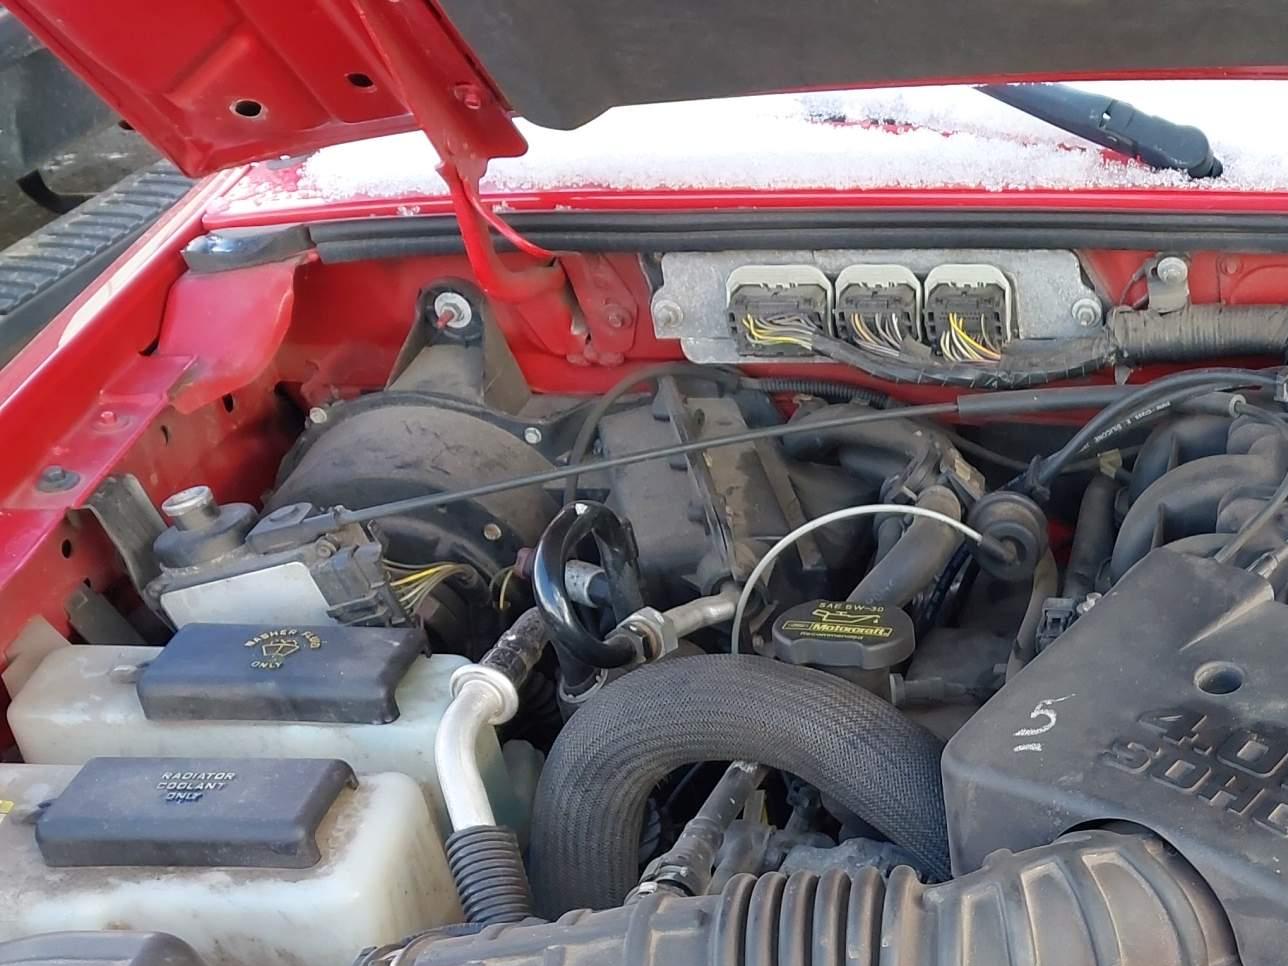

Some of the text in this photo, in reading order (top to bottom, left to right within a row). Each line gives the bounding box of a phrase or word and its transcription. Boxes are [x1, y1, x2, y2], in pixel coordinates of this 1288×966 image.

[819, 602, 843, 610] SAE
[812, 622, 885, 636] Motorcraft
[250, 660, 283, 669] ONLY
[161, 771, 236, 780] RADIATOR
[156, 782, 226, 790] COOLANT
[166, 791, 204, 801] ONLY
